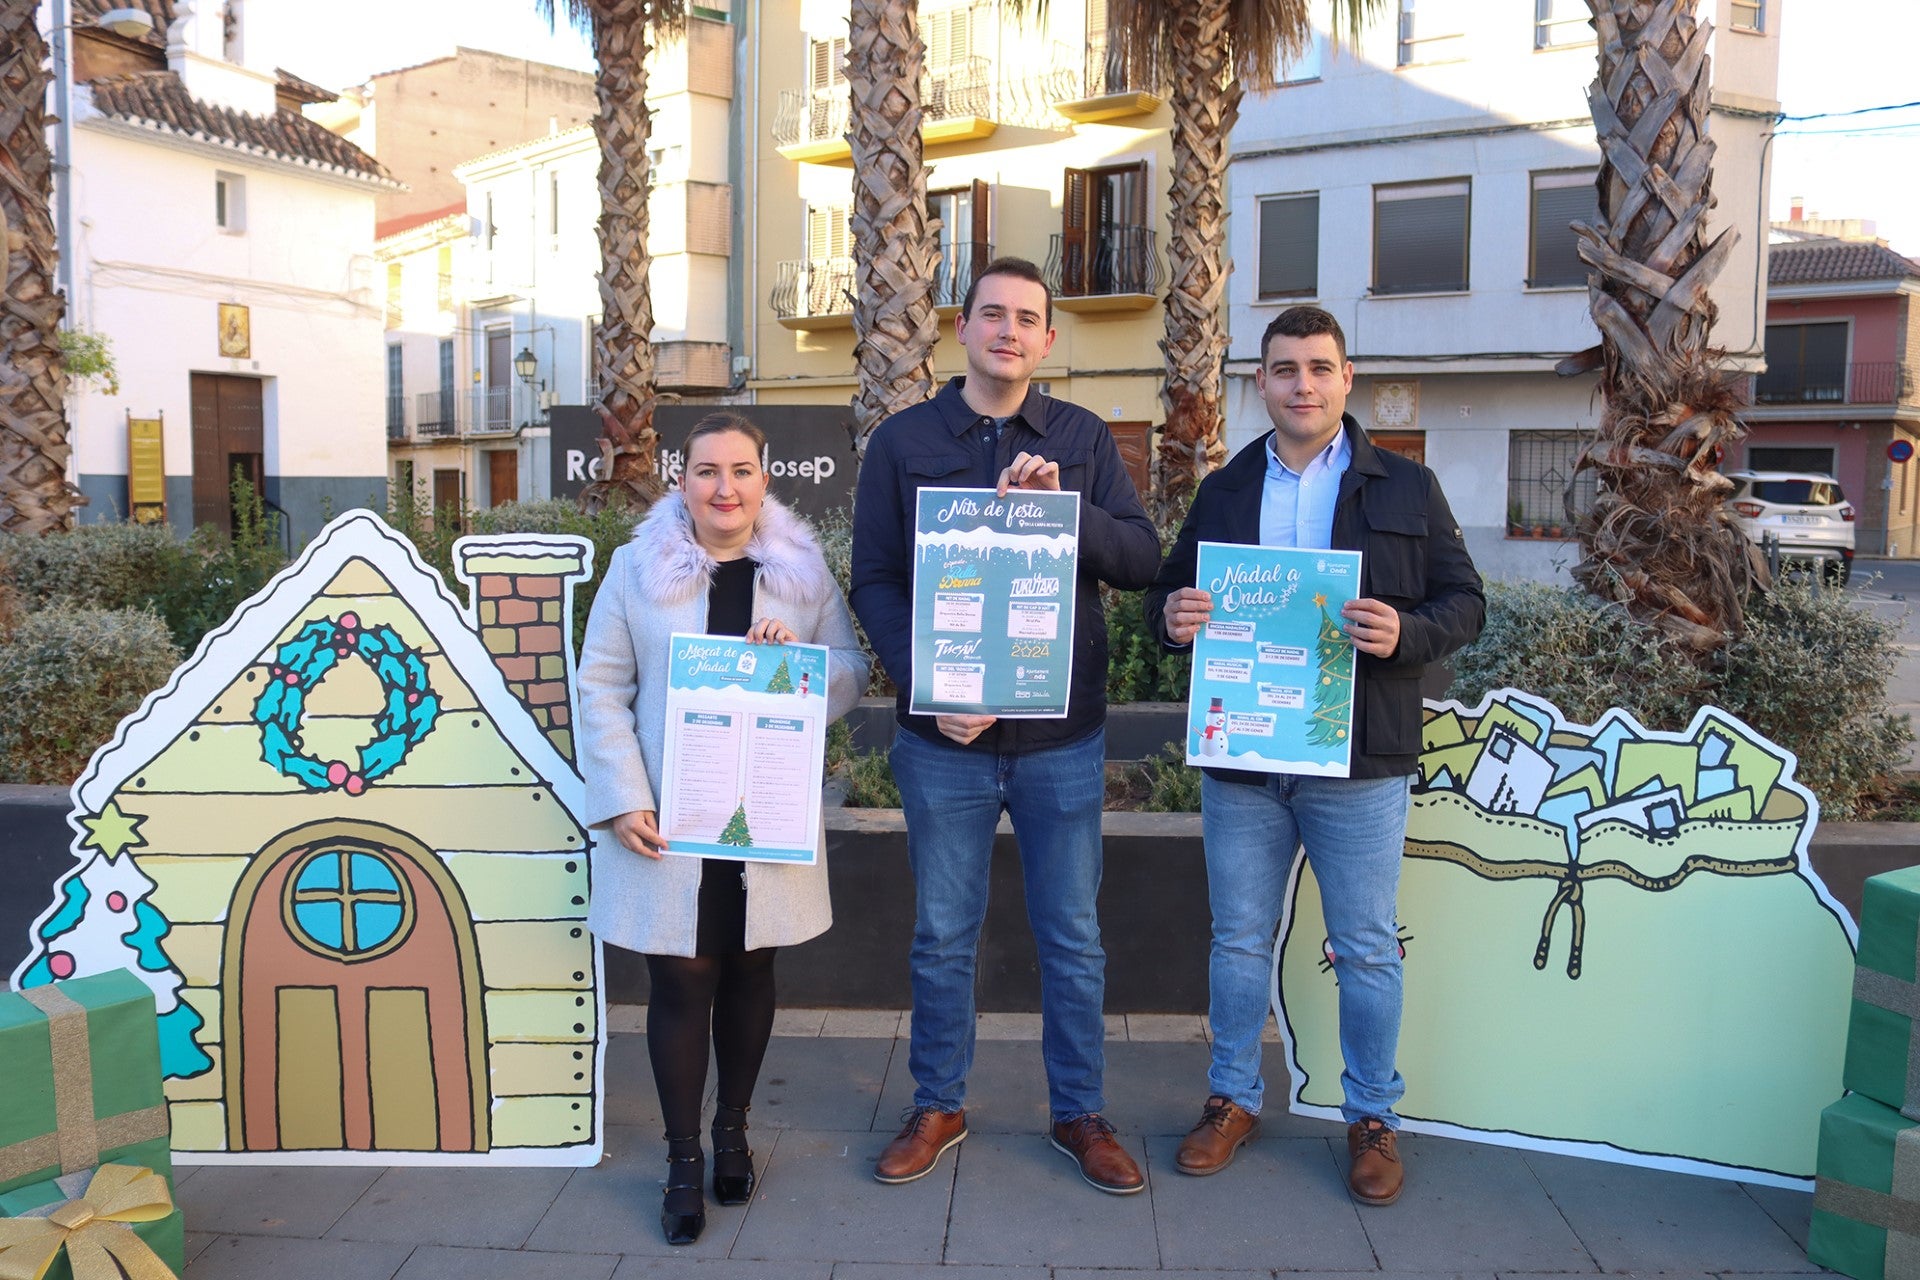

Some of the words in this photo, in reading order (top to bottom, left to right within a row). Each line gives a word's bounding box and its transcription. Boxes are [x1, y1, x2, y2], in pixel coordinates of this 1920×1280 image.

[938, 498, 980, 522] Nits
[984, 500, 1004, 516] de
[1006, 502, 1045, 528] festa
[1010, 578, 1059, 597] TUKUTAKA
[1210, 563, 1282, 594] Nadal
[1287, 568, 1301, 582] a
[1223, 585, 1277, 612] Onda
[678, 644, 720, 660] Mercat
[724, 646, 737, 658] de
[688, 660, 731, 676] Nadal
